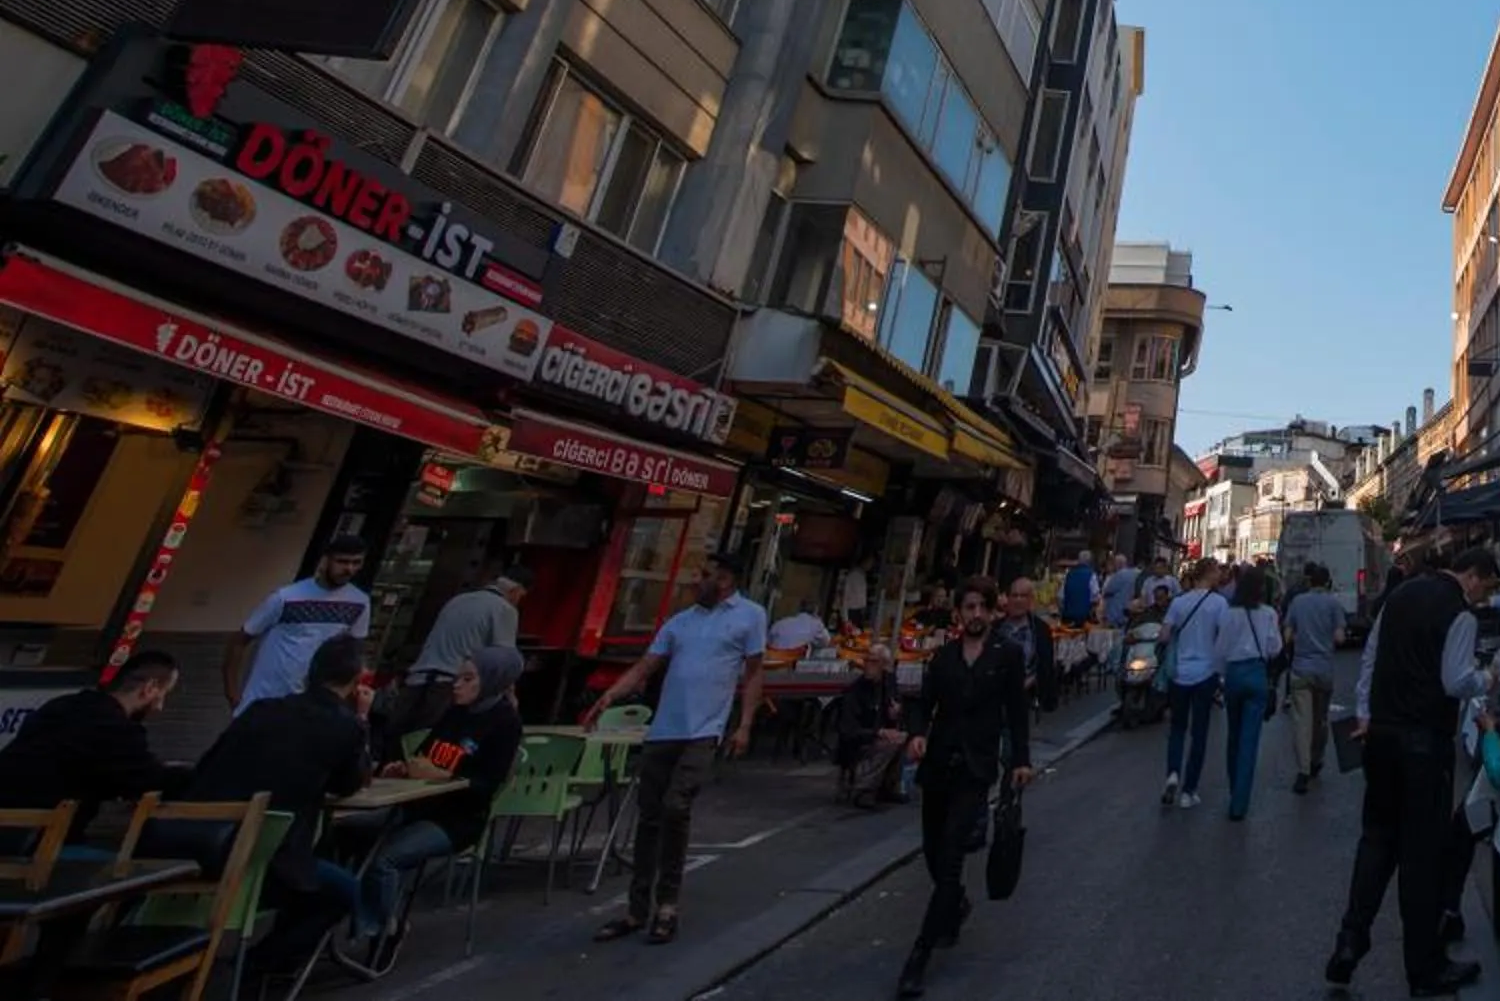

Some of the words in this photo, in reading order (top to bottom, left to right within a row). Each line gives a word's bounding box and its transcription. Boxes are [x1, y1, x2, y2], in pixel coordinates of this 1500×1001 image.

[174, 333, 265, 385] DÖNER
[276, 362, 316, 399] İST
[671, 470, 710, 490] DÖNER
